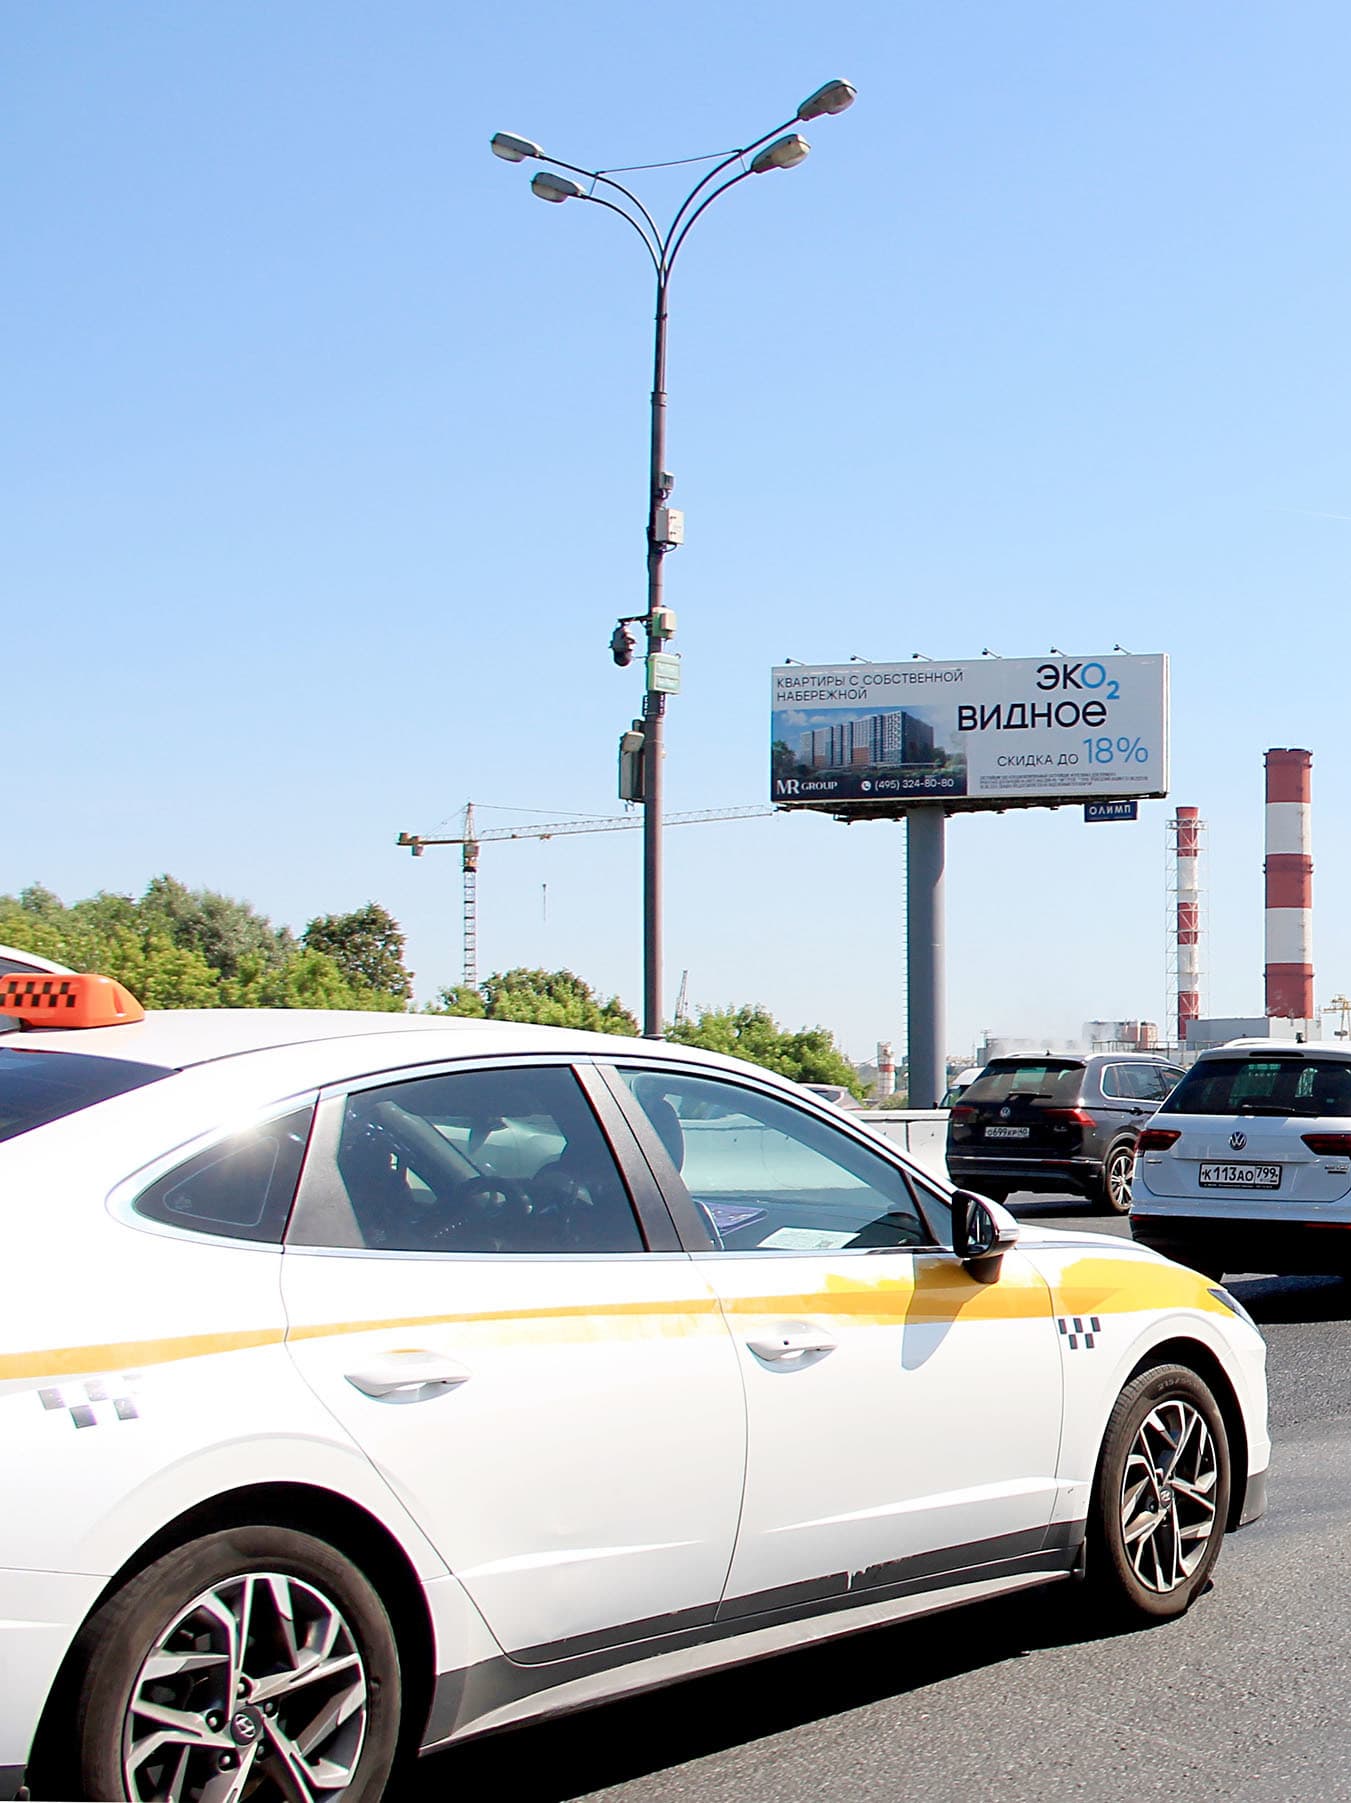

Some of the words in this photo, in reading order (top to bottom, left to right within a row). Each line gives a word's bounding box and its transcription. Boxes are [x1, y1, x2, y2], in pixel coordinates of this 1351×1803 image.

[777, 675, 845, 688] КВАРТИРЫ
[849, 675, 859, 686] С
[863, 668, 964, 686] СОБСТВЕННОЙ
[777, 686, 867, 702] НАБЕРЕЖНОЙ
[997, 754, 1053, 767] СКИДКА
[1057, 753, 1079, 766] ДО
[1083, 737, 1149, 764] 18%
[776, 779, 800, 795] MR
[801, 782, 838, 791] GROUP
[875, 779, 900, 792] (495)
[902, 778, 955, 789] 324-80-80
[1089, 804, 1132, 816] ОЛИМП
[1203, 1166, 1254, 1182] К113АО
